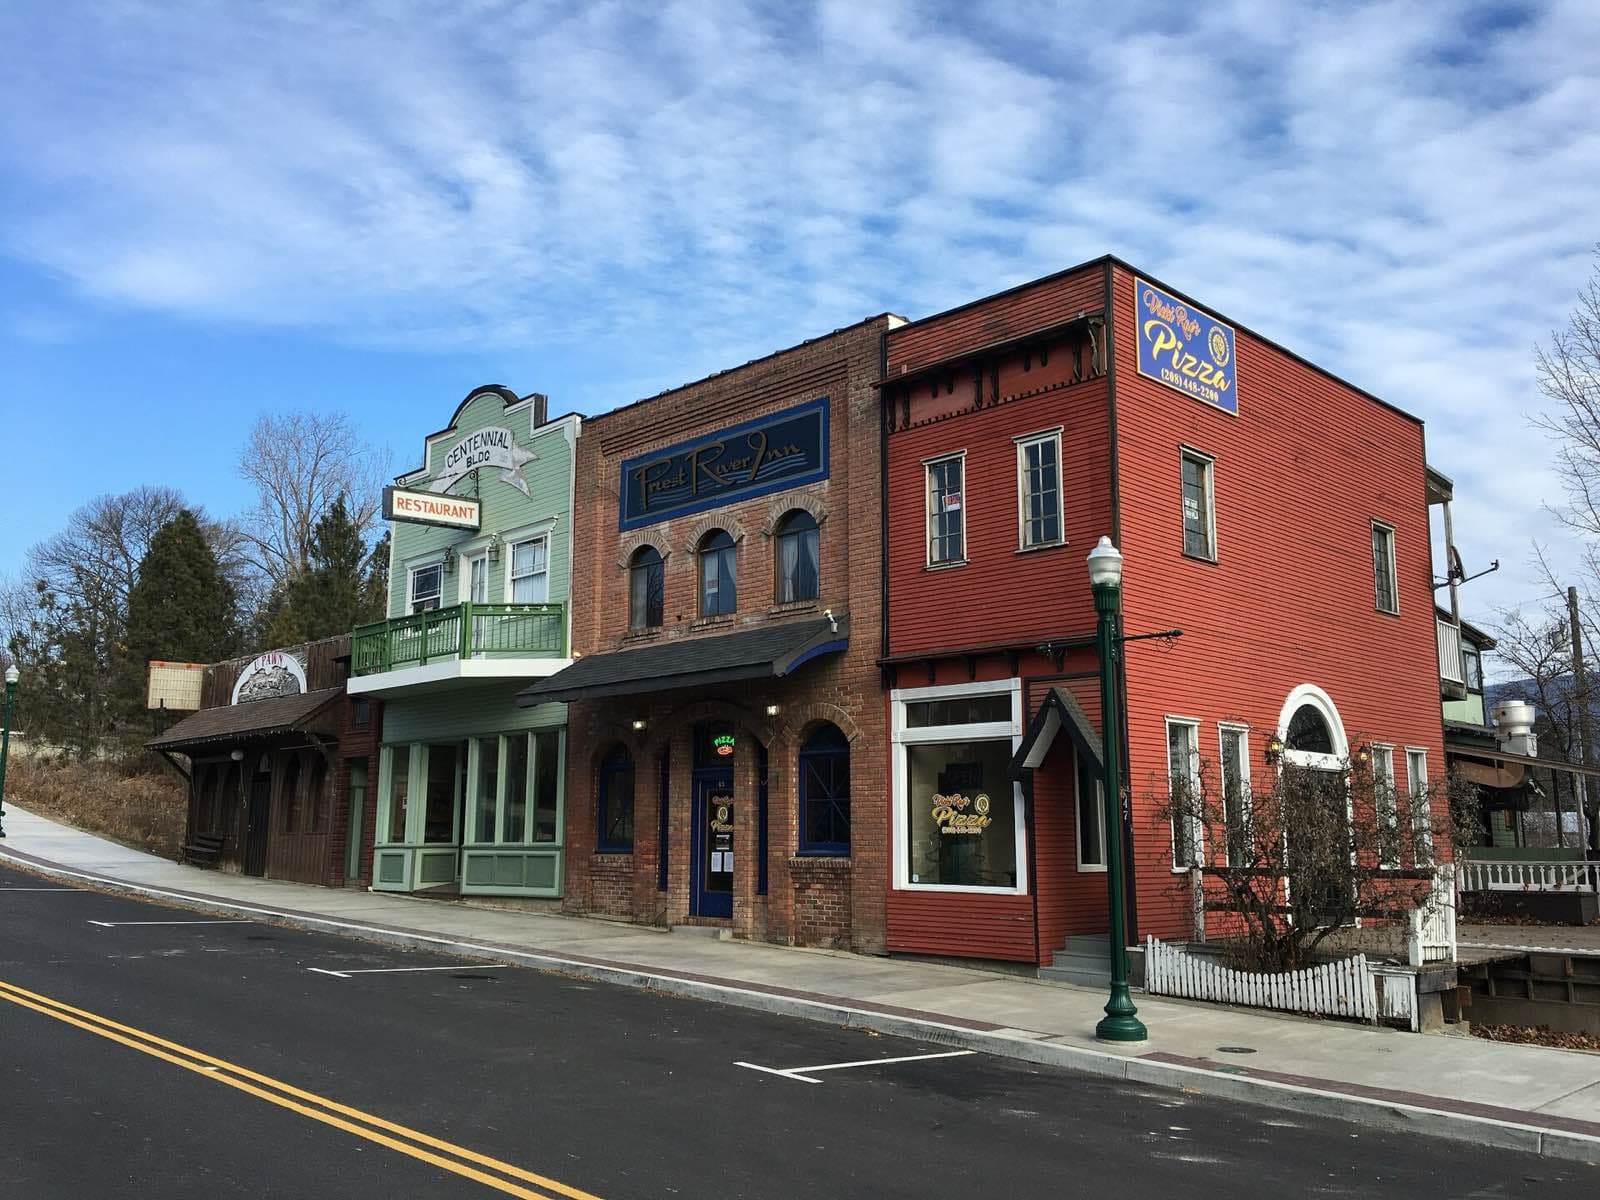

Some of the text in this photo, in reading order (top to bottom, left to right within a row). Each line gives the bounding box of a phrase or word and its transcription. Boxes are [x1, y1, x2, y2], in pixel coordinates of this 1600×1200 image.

[1143, 319, 1231, 391] Pizza
[446, 430, 509, 469] CENTENNIAL
[466, 450, 490, 469] BLDG
[685, 439, 750, 496] River
[747, 429, 801, 481] Inn
[396, 496, 475, 520] RESTAURANT
[931, 806, 993, 828] Pizza
